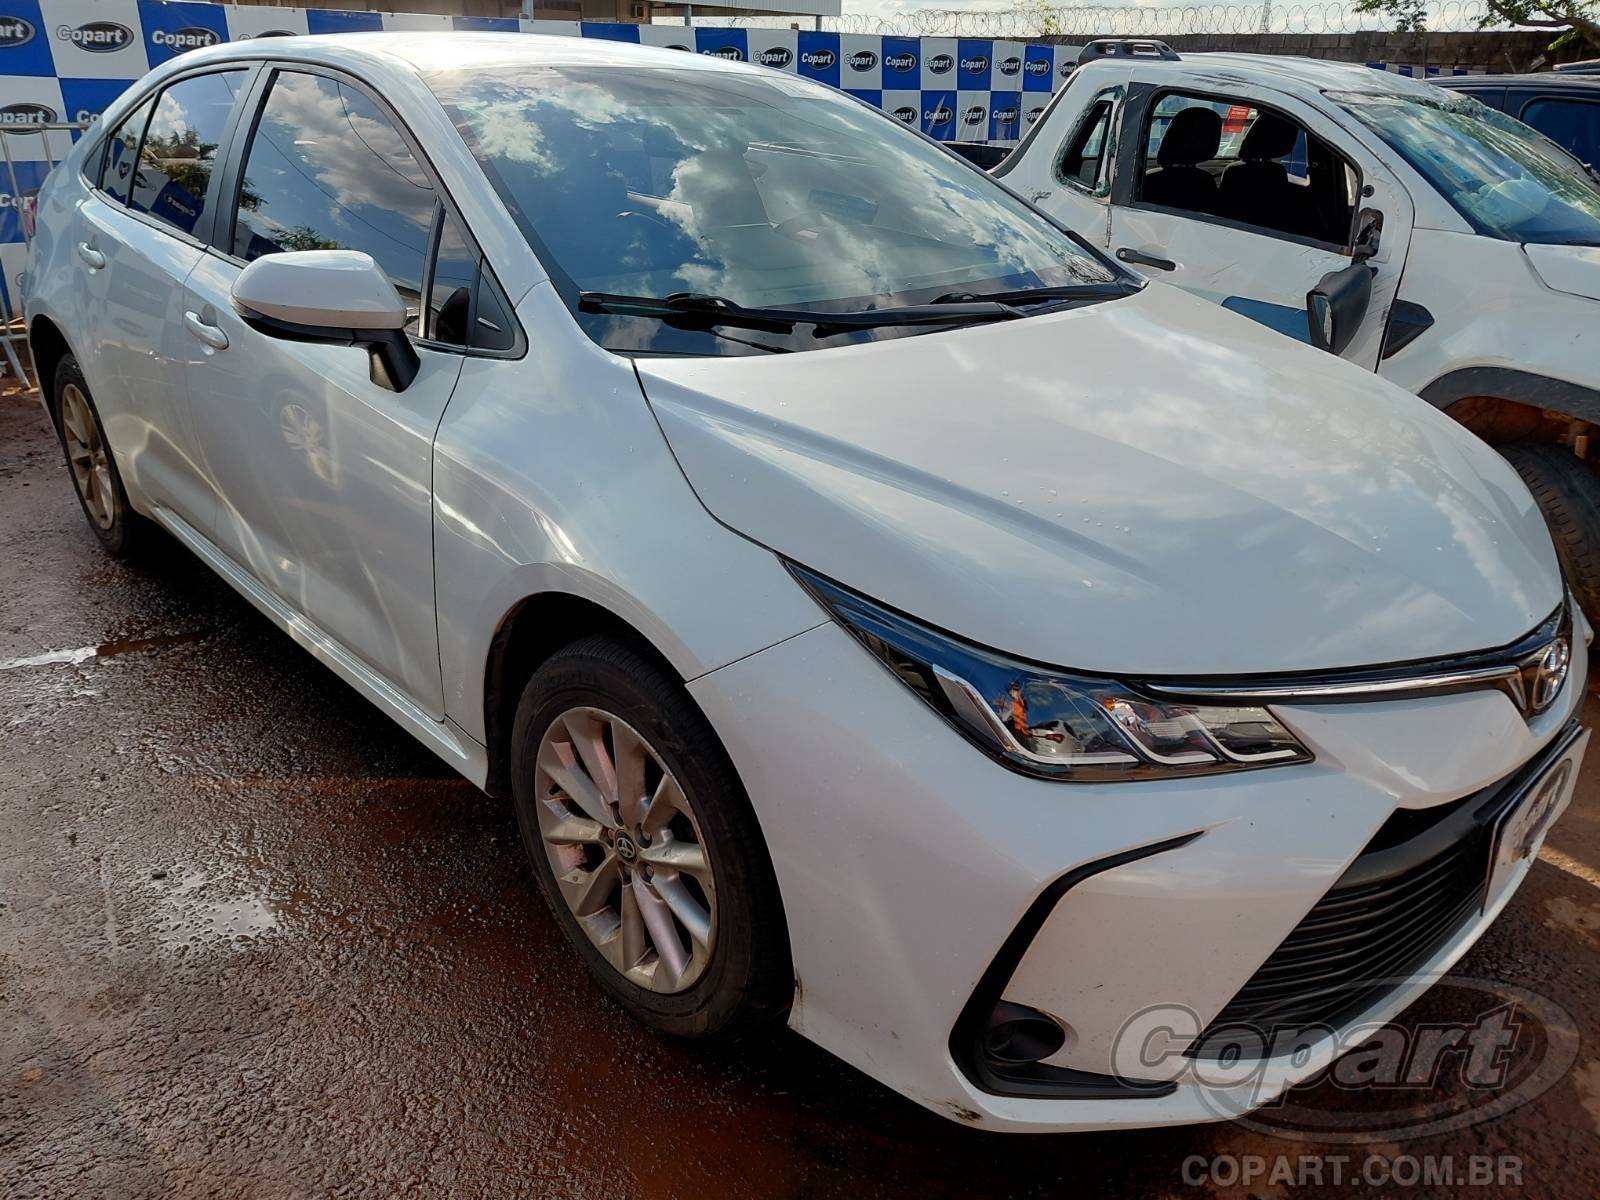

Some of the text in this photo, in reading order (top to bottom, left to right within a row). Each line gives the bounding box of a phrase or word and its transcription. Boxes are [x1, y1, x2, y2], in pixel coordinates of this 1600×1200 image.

[0, 23, 25, 38] art
[57, 24, 123, 44] Copart
[152, 30, 212, 47] Copart
[753, 50, 788, 64] Copart
[801, 52, 832, 66] Copart
[844, 53, 873, 67] Copart
[885, 56, 912, 68] Copart
[923, 57, 950, 68] Copart
[960, 59, 985, 70] Copart
[995, 60, 1020, 71] Copart
[1025, 61, 1047, 73] Copart
[0, 111, 46, 124] part
[924, 110, 949, 122] Copart
